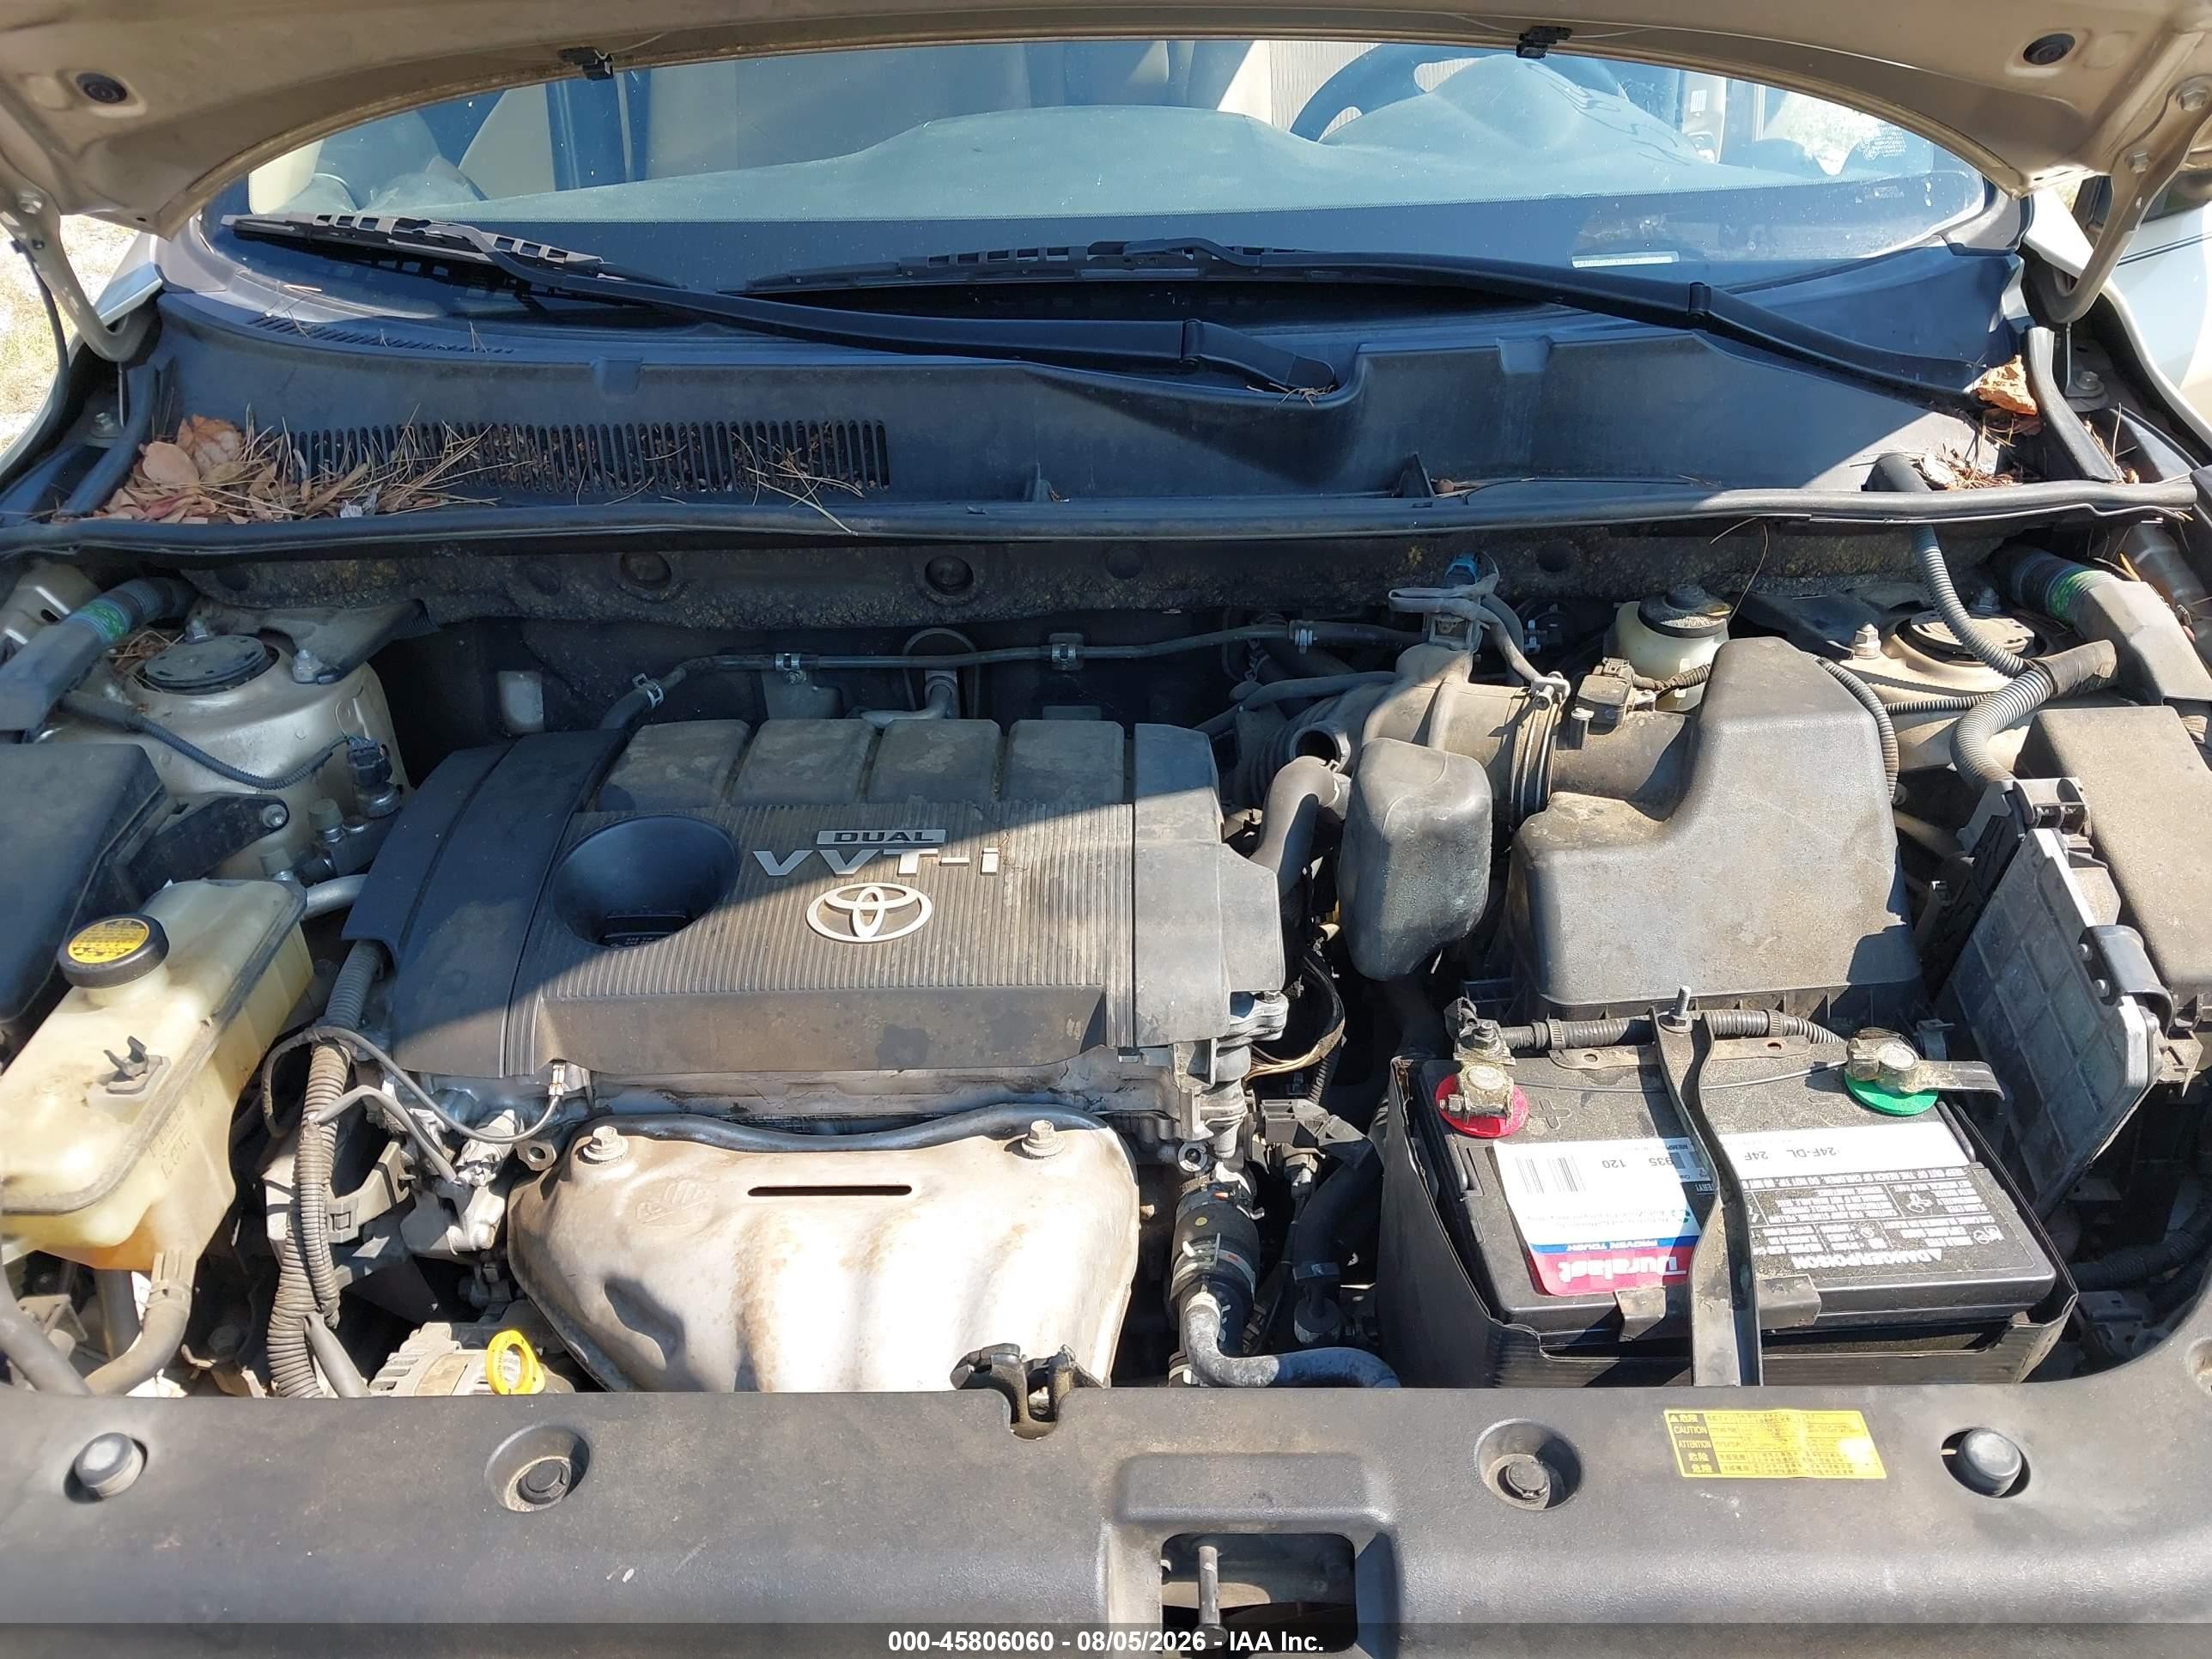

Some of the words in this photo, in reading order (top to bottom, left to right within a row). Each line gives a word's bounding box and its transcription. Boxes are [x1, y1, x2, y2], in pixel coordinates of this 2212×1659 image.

[833, 830, 933, 843] DUAL
[752, 847, 1000, 877] VVT-i
[1744, 1152, 1769, 1161] 24F
[1786, 1146, 1837, 1158] 24F-DL
[1601, 1159, 1626, 1169] 120
[1558, 1256, 1686, 1283] Duralast
[1674, 1425, 1707, 1434] CAUTION
[1678, 1440, 1711, 1449] ATTENTION
